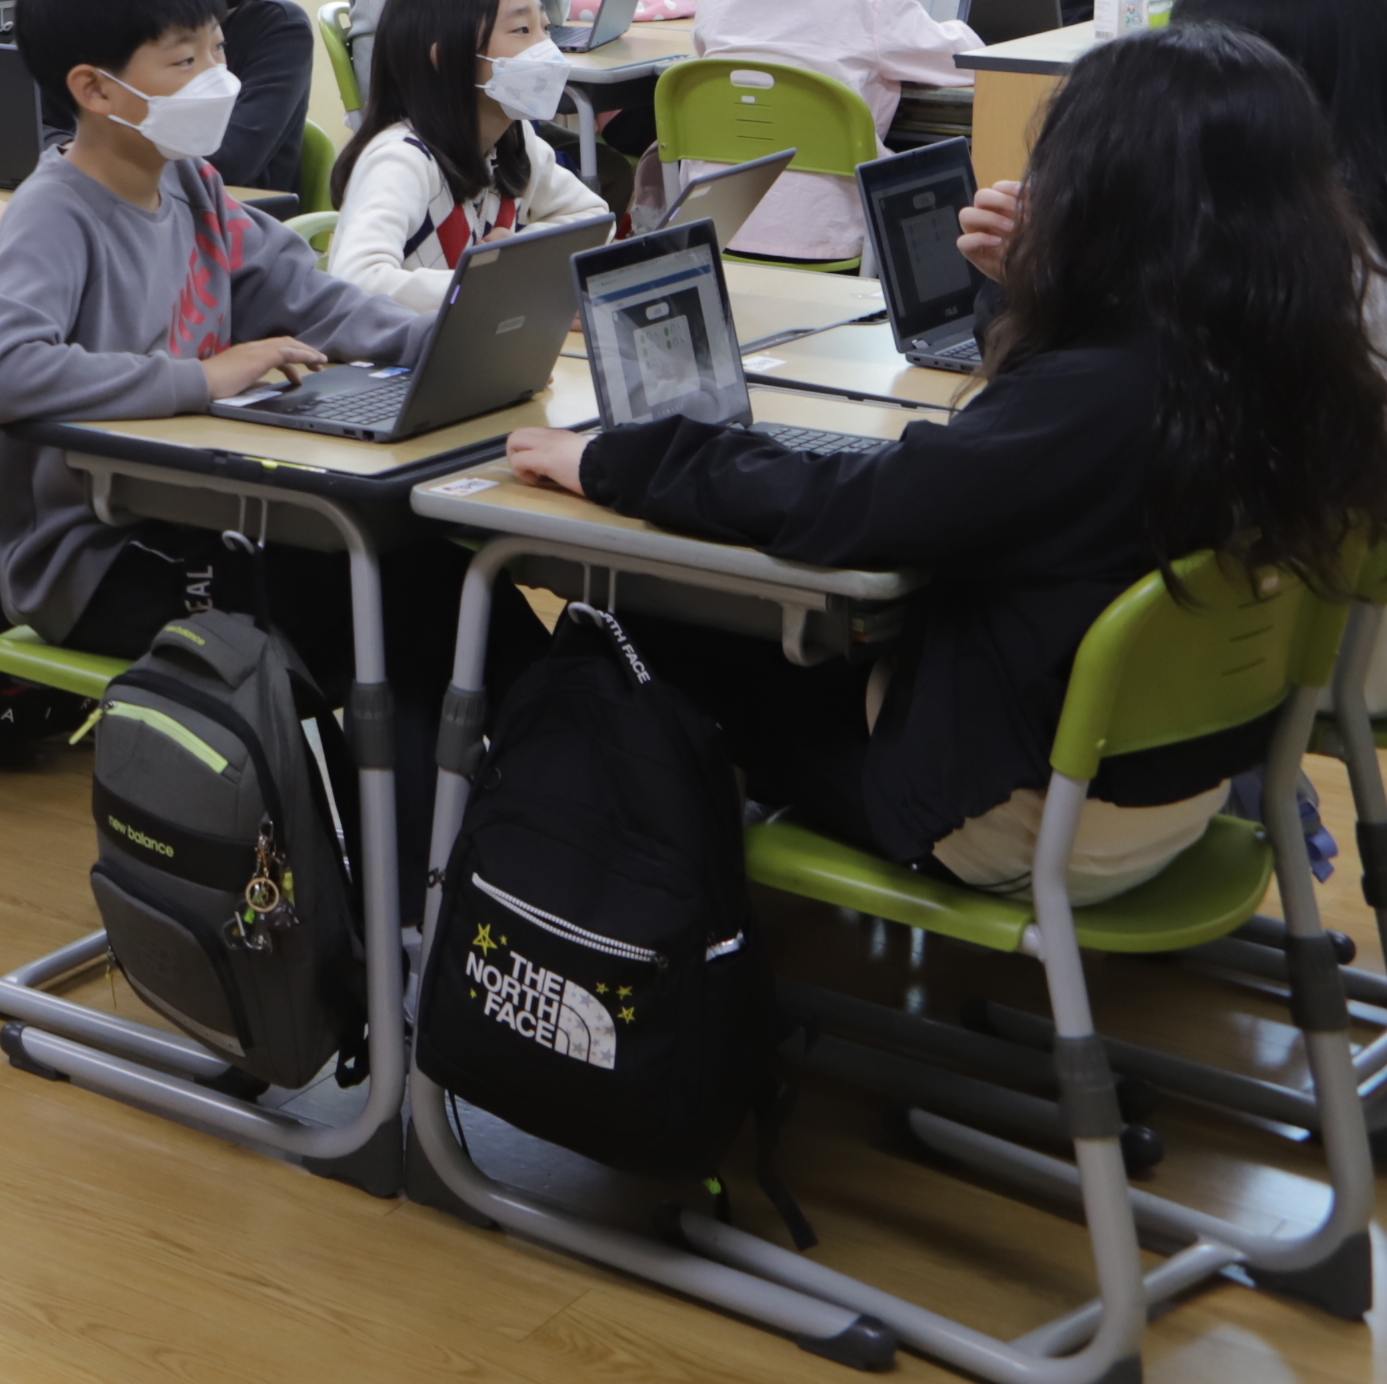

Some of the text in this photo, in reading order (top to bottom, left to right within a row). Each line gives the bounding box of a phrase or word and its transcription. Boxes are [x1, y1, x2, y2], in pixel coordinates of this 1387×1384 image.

[621, 643, 652, 685] FACE
[107, 814, 175, 859] new balance
[465, 950, 561, 1026] NORTH
[509, 950, 565, 1002] THE
[483, 991, 556, 1050] FACE
